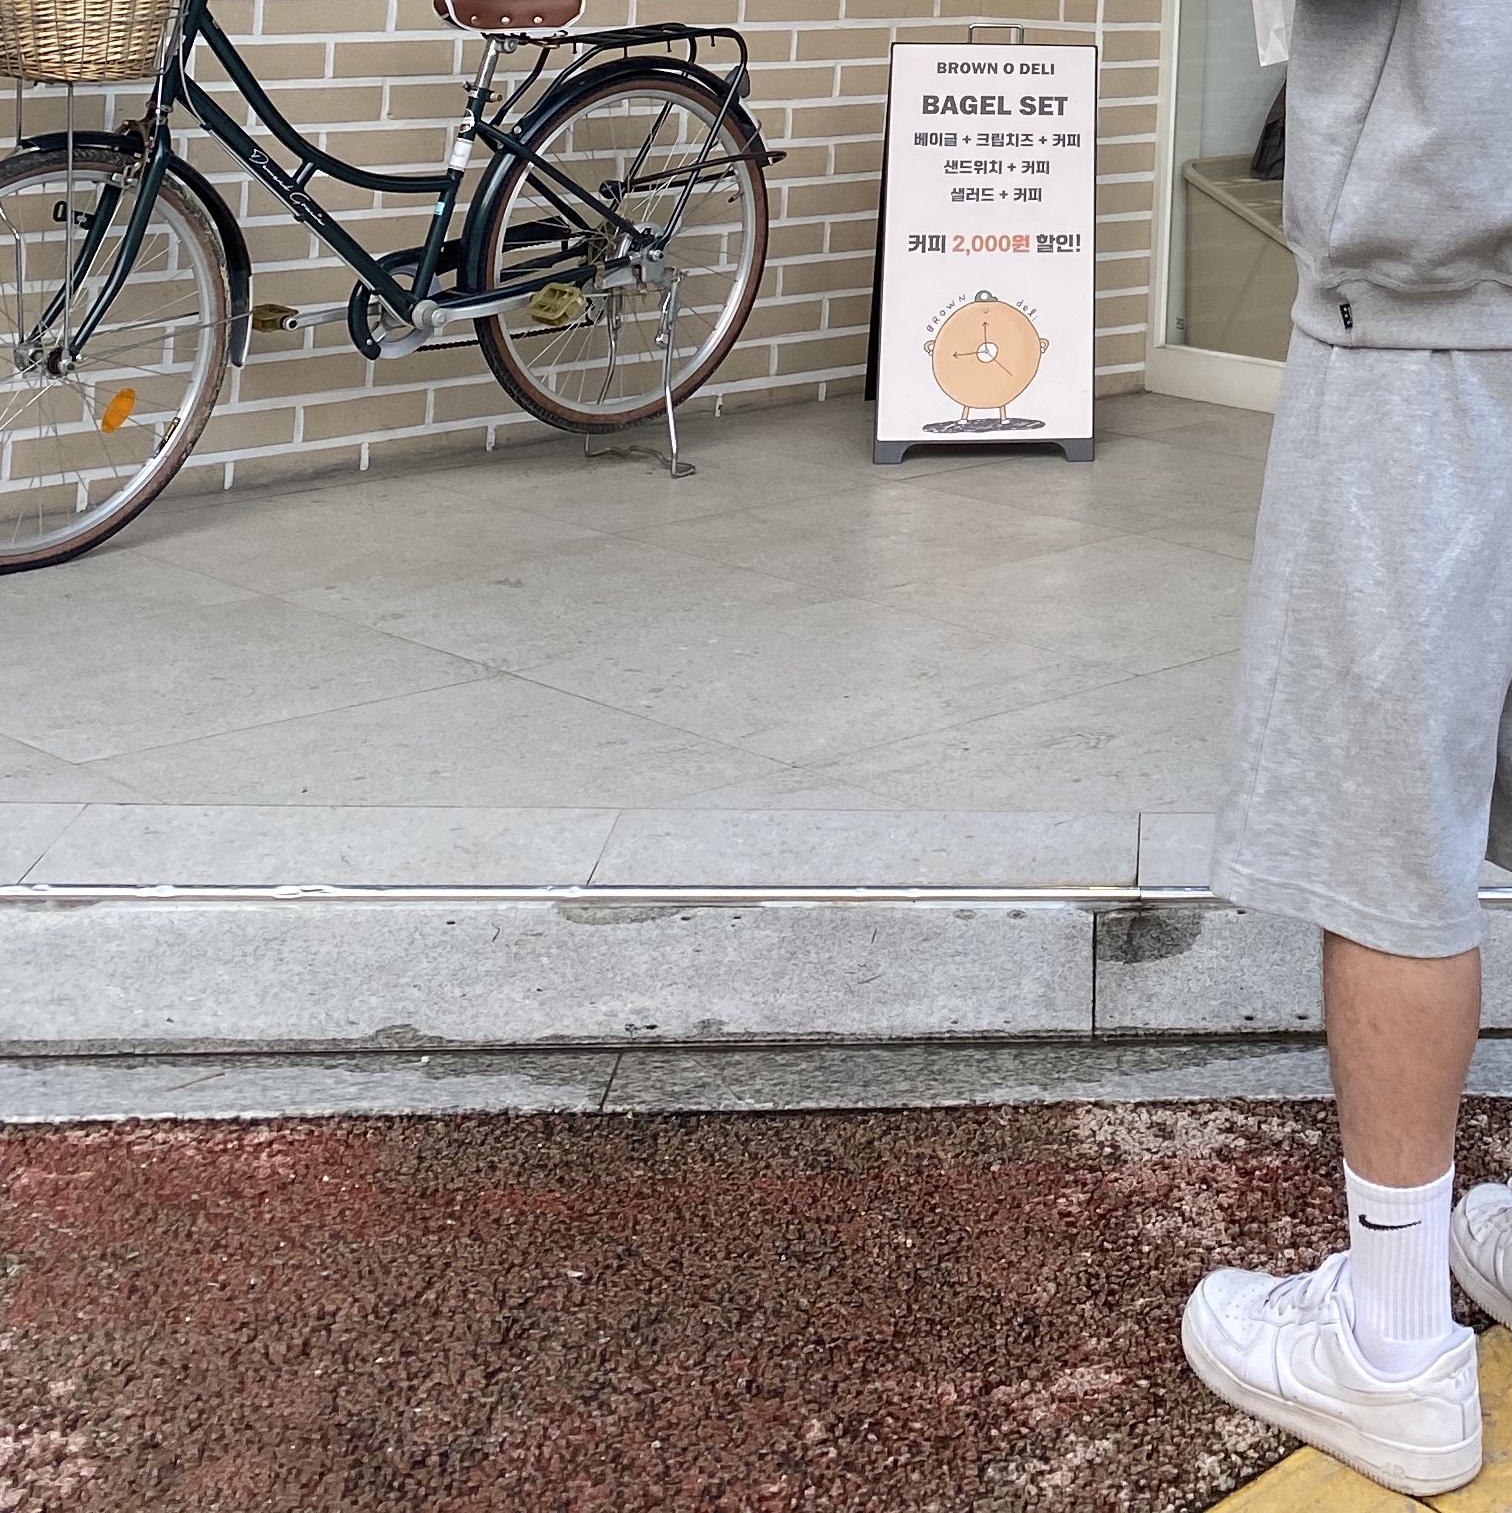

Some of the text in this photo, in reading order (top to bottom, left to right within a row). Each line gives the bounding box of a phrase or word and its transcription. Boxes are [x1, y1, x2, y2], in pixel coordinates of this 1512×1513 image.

[937, 61, 1055, 75] BROWN O DELI
[922, 95, 1069, 116] BAGEL SET
[914, 132, 958, 147] 베이글
[976, 132, 1034, 148] 크림치즈
[1052, 133, 1081, 148] 커피
[944, 159, 1003, 175] 샌드위치
[1021, 160, 1050, 175] 커피
[950, 187, 995, 202] 샐러드
[1013, 187, 1042, 202] 커피
[908, 233, 1081, 256] 커피 2,000원 할인!
[926, 293, 966, 333] BROWN
